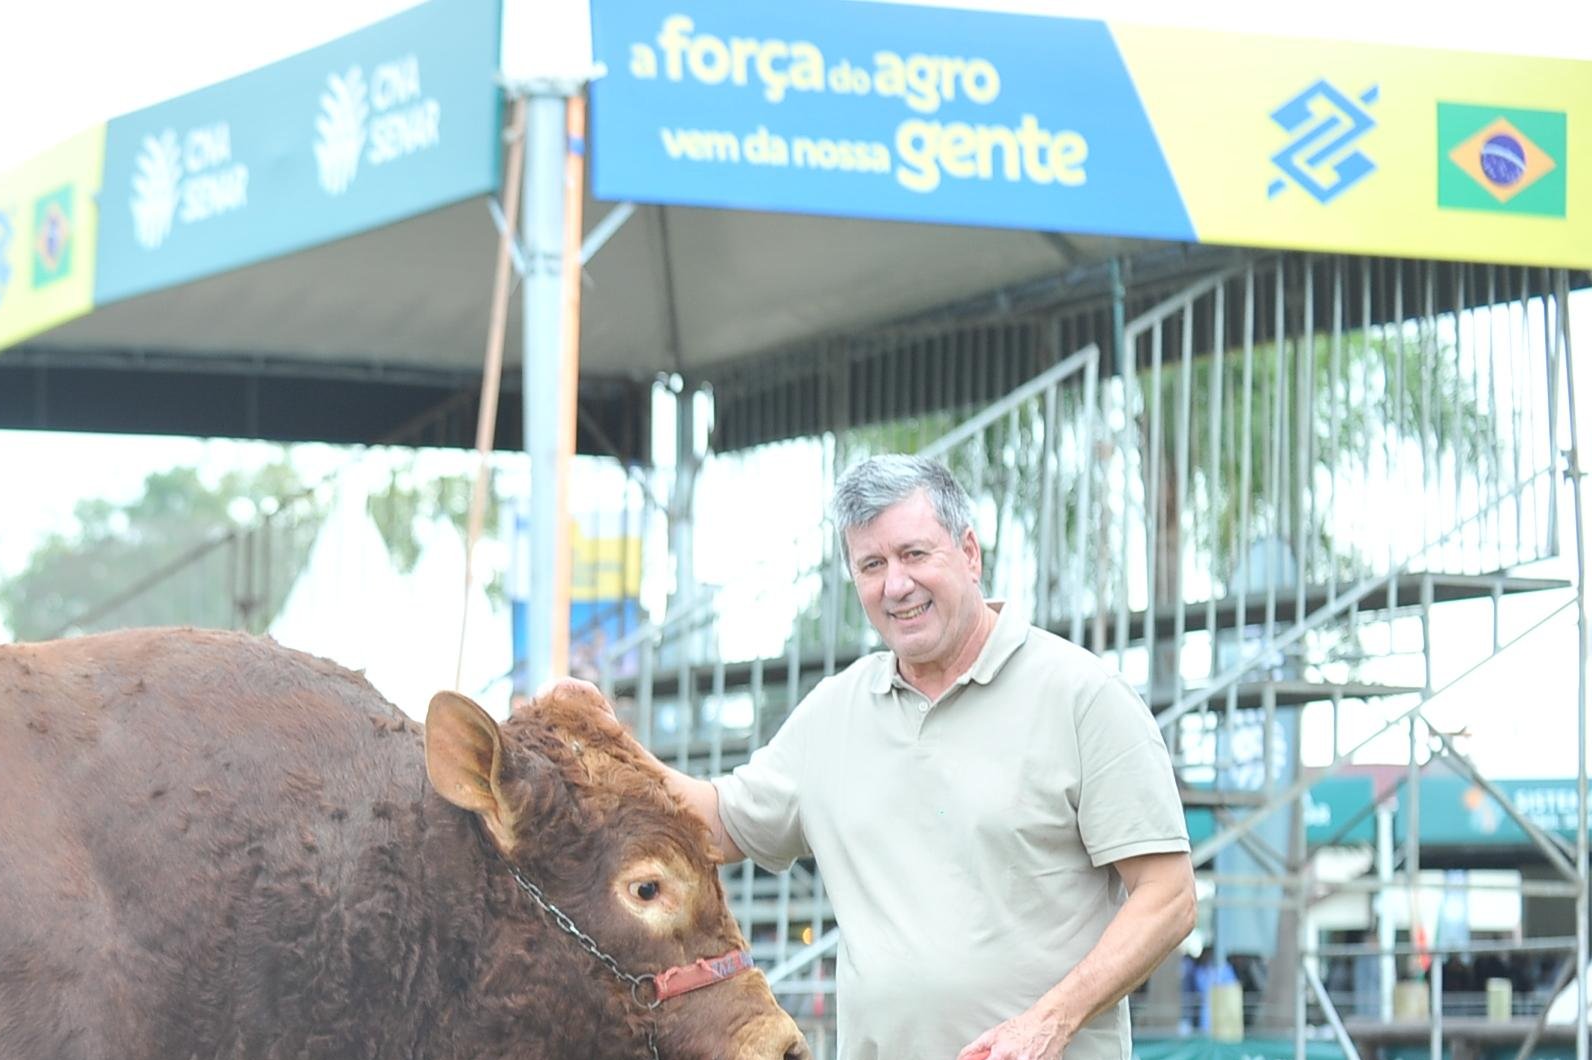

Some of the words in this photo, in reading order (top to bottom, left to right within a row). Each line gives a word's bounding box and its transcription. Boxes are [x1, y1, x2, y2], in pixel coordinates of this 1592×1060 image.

[369, 53, 421, 110] CNA
[629, 42, 658, 79] a
[657, 14, 825, 102] força
[828, 60, 871, 95] do
[874, 50, 1001, 113] agro
[183, 121, 232, 172] CNA
[366, 98, 440, 165] SENAR
[660, 127, 740, 163] vem
[743, 125, 789, 166] da
[792, 136, 891, 173] nossa
[895, 113, 1088, 193] gente
[180, 163, 250, 223] SENAR
